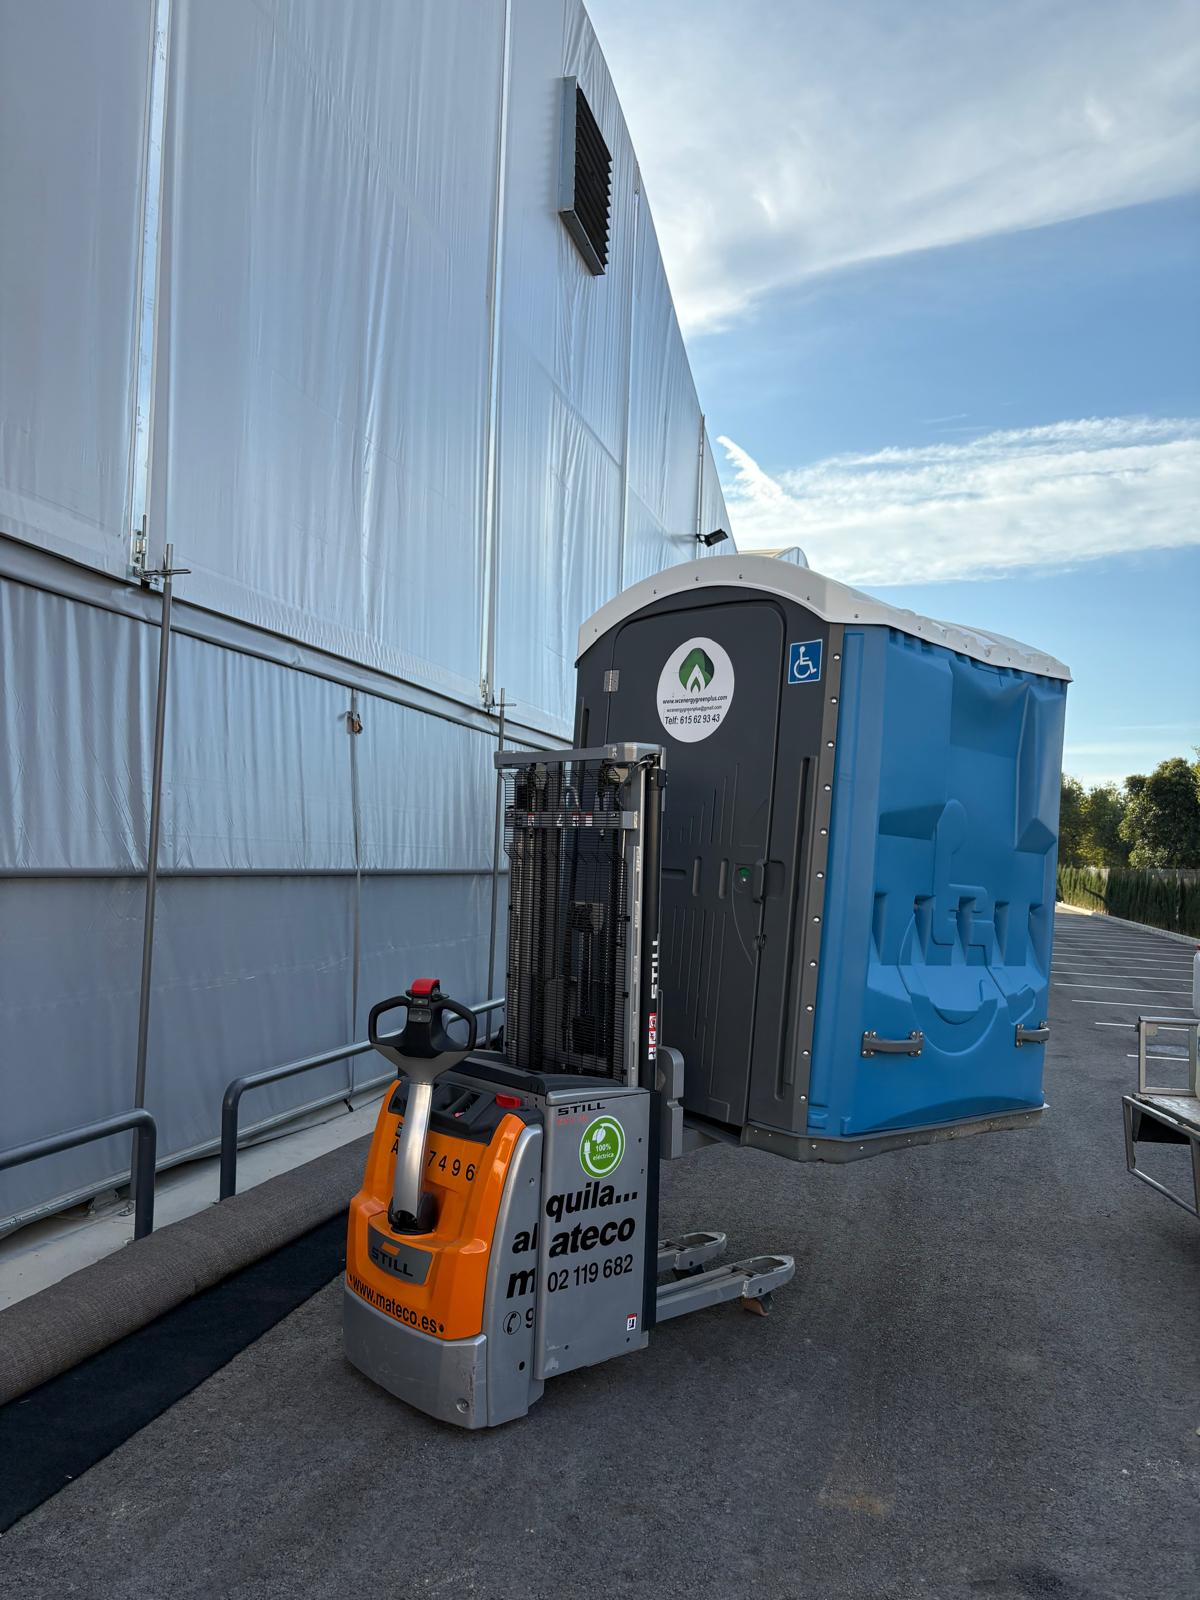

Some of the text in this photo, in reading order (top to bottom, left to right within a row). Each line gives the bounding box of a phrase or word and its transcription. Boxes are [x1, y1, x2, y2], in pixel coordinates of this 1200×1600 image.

[663, 695, 728, 705] www.wcenergygreenplus.com
[665, 713, 720, 725] Telf: 615 62 93 43
[558, 1102, 606, 1116] STILL
[595, 1143, 611, 1152] 100%
[371, 1246, 414, 1277] STILL
[547, 1254, 633, 1293] 02 119 682
